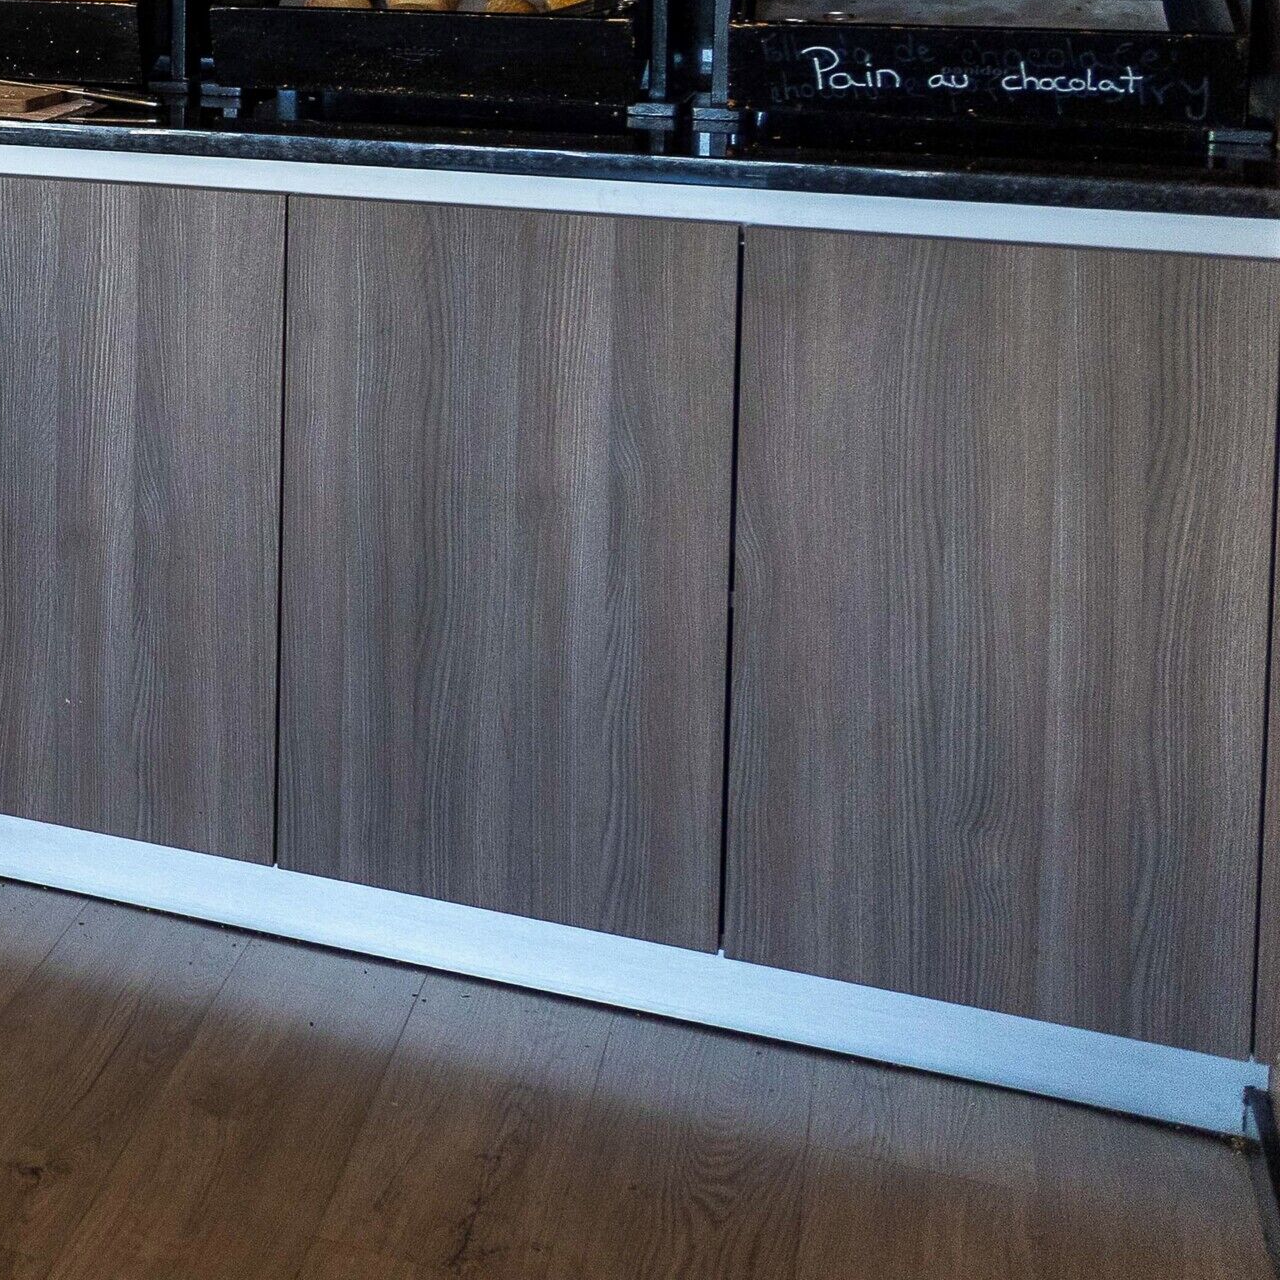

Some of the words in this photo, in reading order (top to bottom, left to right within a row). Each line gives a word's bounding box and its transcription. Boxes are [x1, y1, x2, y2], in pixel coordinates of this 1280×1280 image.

[800, 45, 901, 90] Pain
[927, 73, 969, 89] au
[1000, 60, 1144, 94] chocolat
